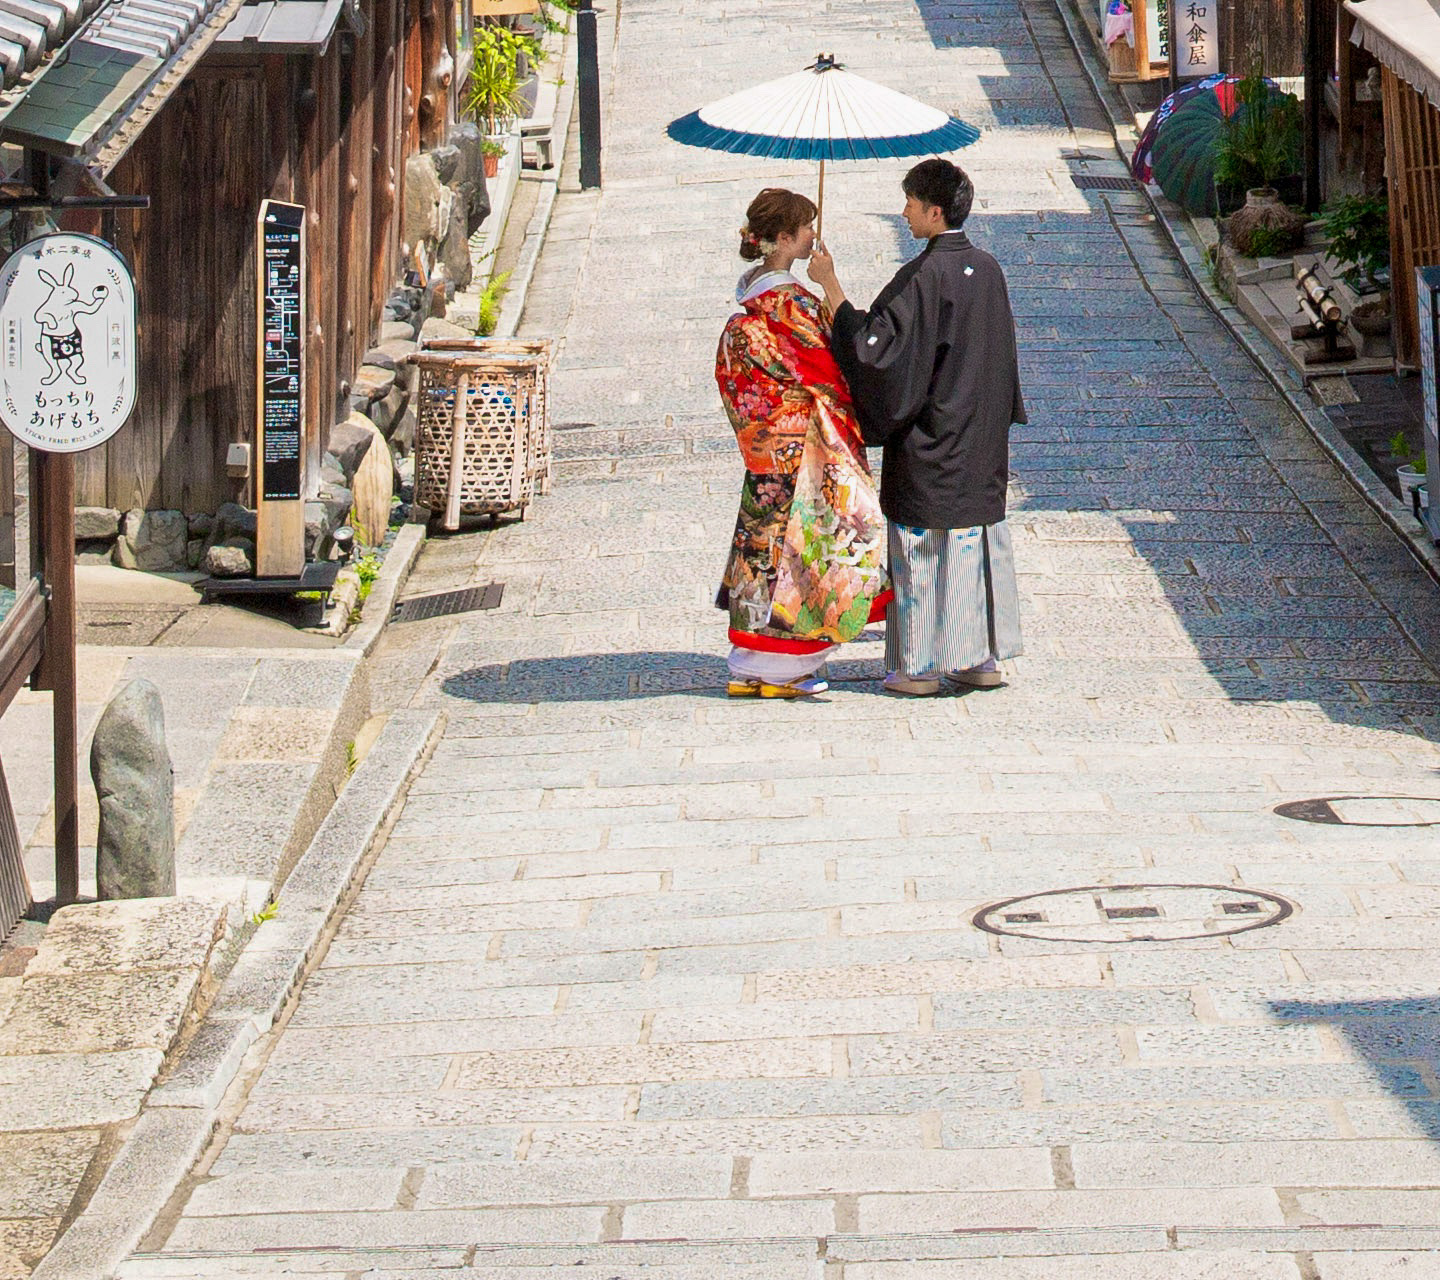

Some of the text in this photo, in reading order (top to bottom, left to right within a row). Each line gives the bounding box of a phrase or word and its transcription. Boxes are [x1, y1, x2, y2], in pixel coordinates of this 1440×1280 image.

[1185, 1, 1208, 66] 和傘屋
[35, 390, 95, 409] もっちり
[30, 410, 100, 429] あげもち
